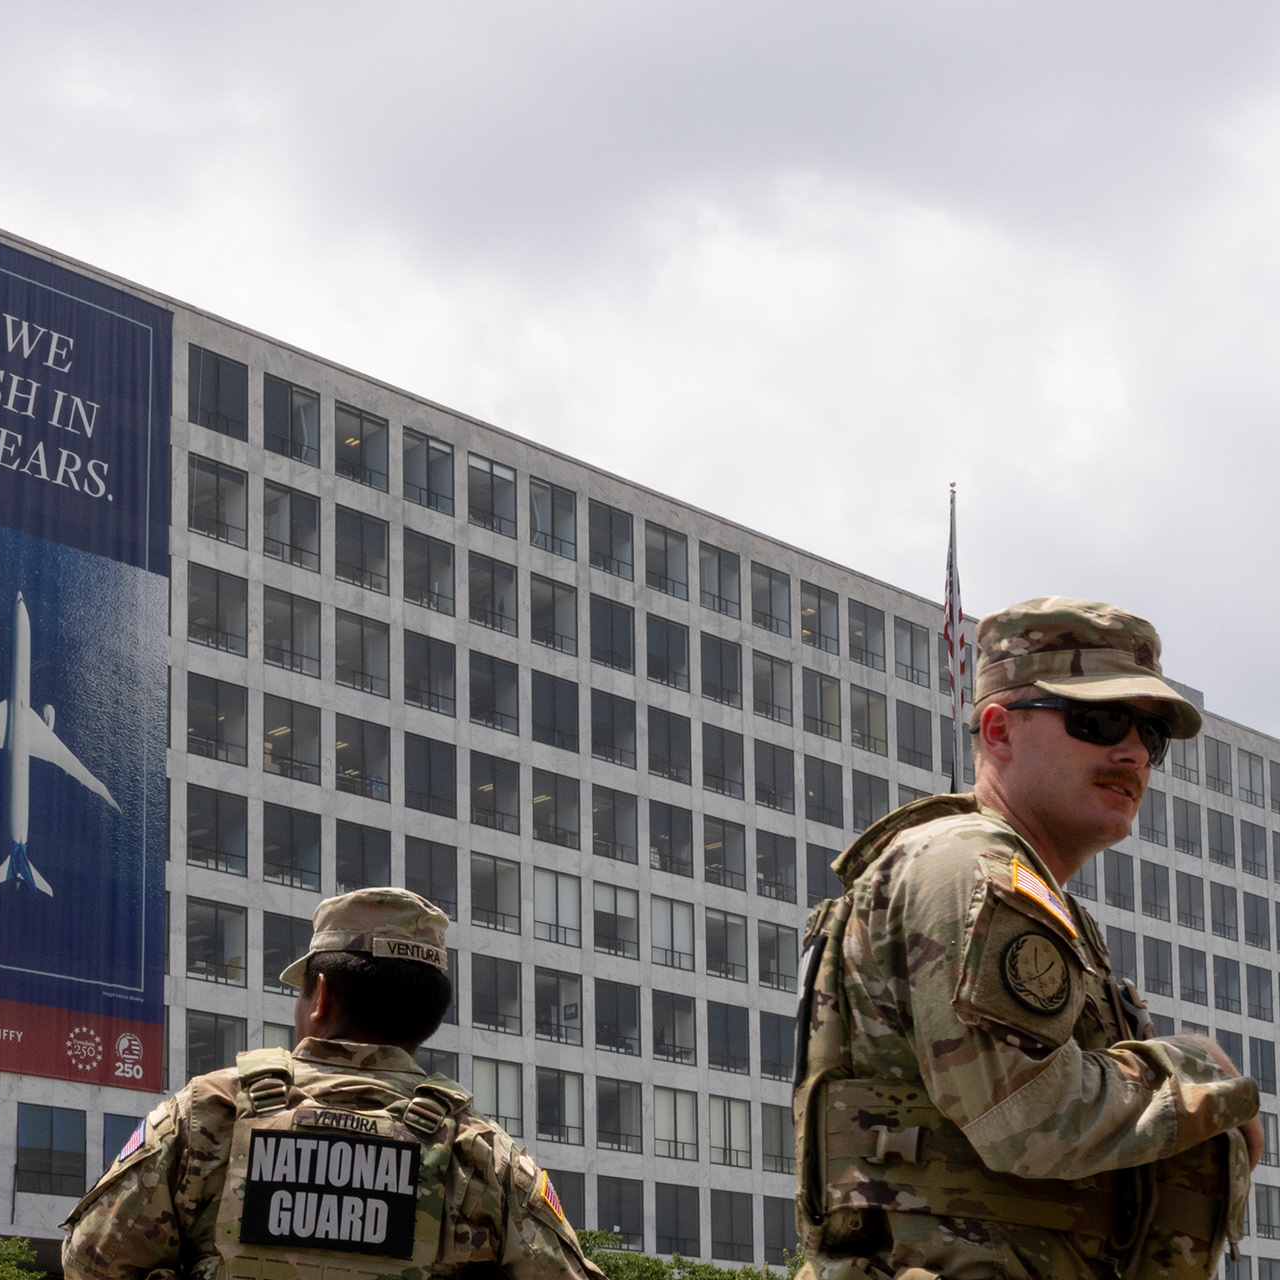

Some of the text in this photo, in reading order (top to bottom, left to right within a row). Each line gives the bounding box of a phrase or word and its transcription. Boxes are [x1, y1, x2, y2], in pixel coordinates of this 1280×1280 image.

[2, 312, 75, 373] WE
[47, 388, 100, 438] IN
[387, 942, 441, 966] VENTURA
[73, 1045, 96, 1059] 250
[114, 1062, 144, 1079] 250
[312, 1109, 378, 1134] VENTURA
[251, 1137, 414, 1195] NATIONAL
[268, 1190, 389, 1243] GUARD
